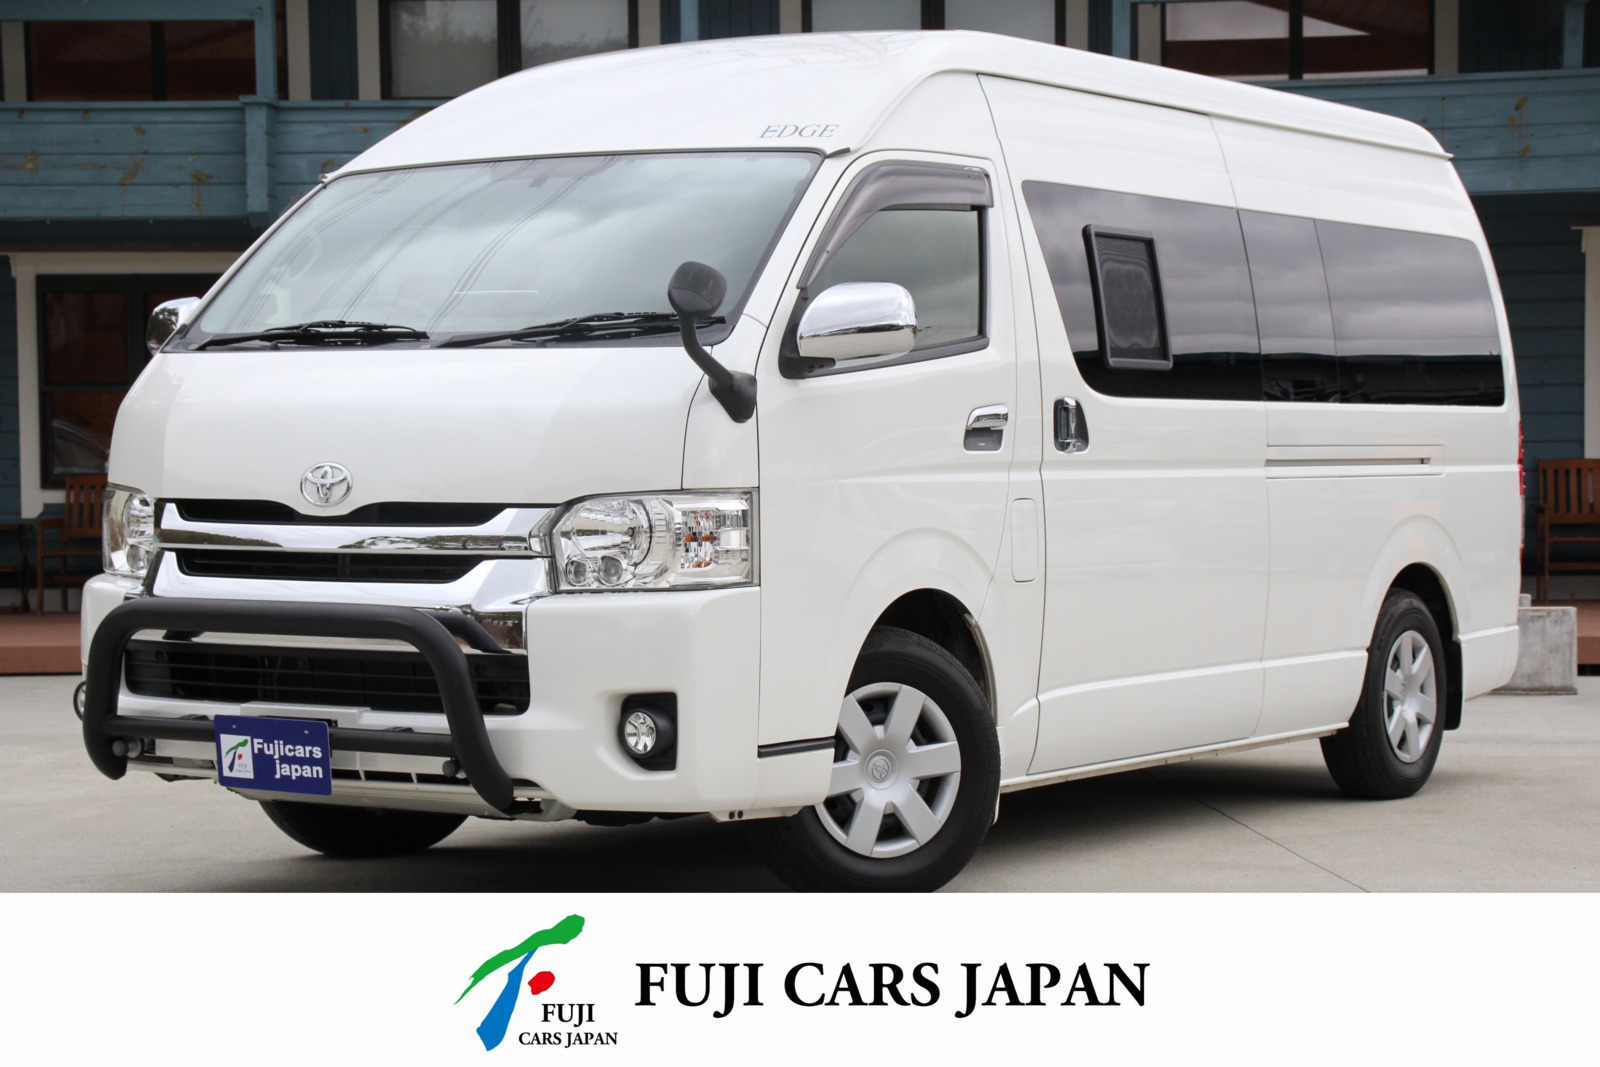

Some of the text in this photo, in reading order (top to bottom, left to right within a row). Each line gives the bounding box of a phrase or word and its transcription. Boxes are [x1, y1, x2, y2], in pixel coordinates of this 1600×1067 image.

[758, 124, 839, 138] EDGE
[253, 738, 323, 759] Fujicars
[275, 760, 323, 780] japan
